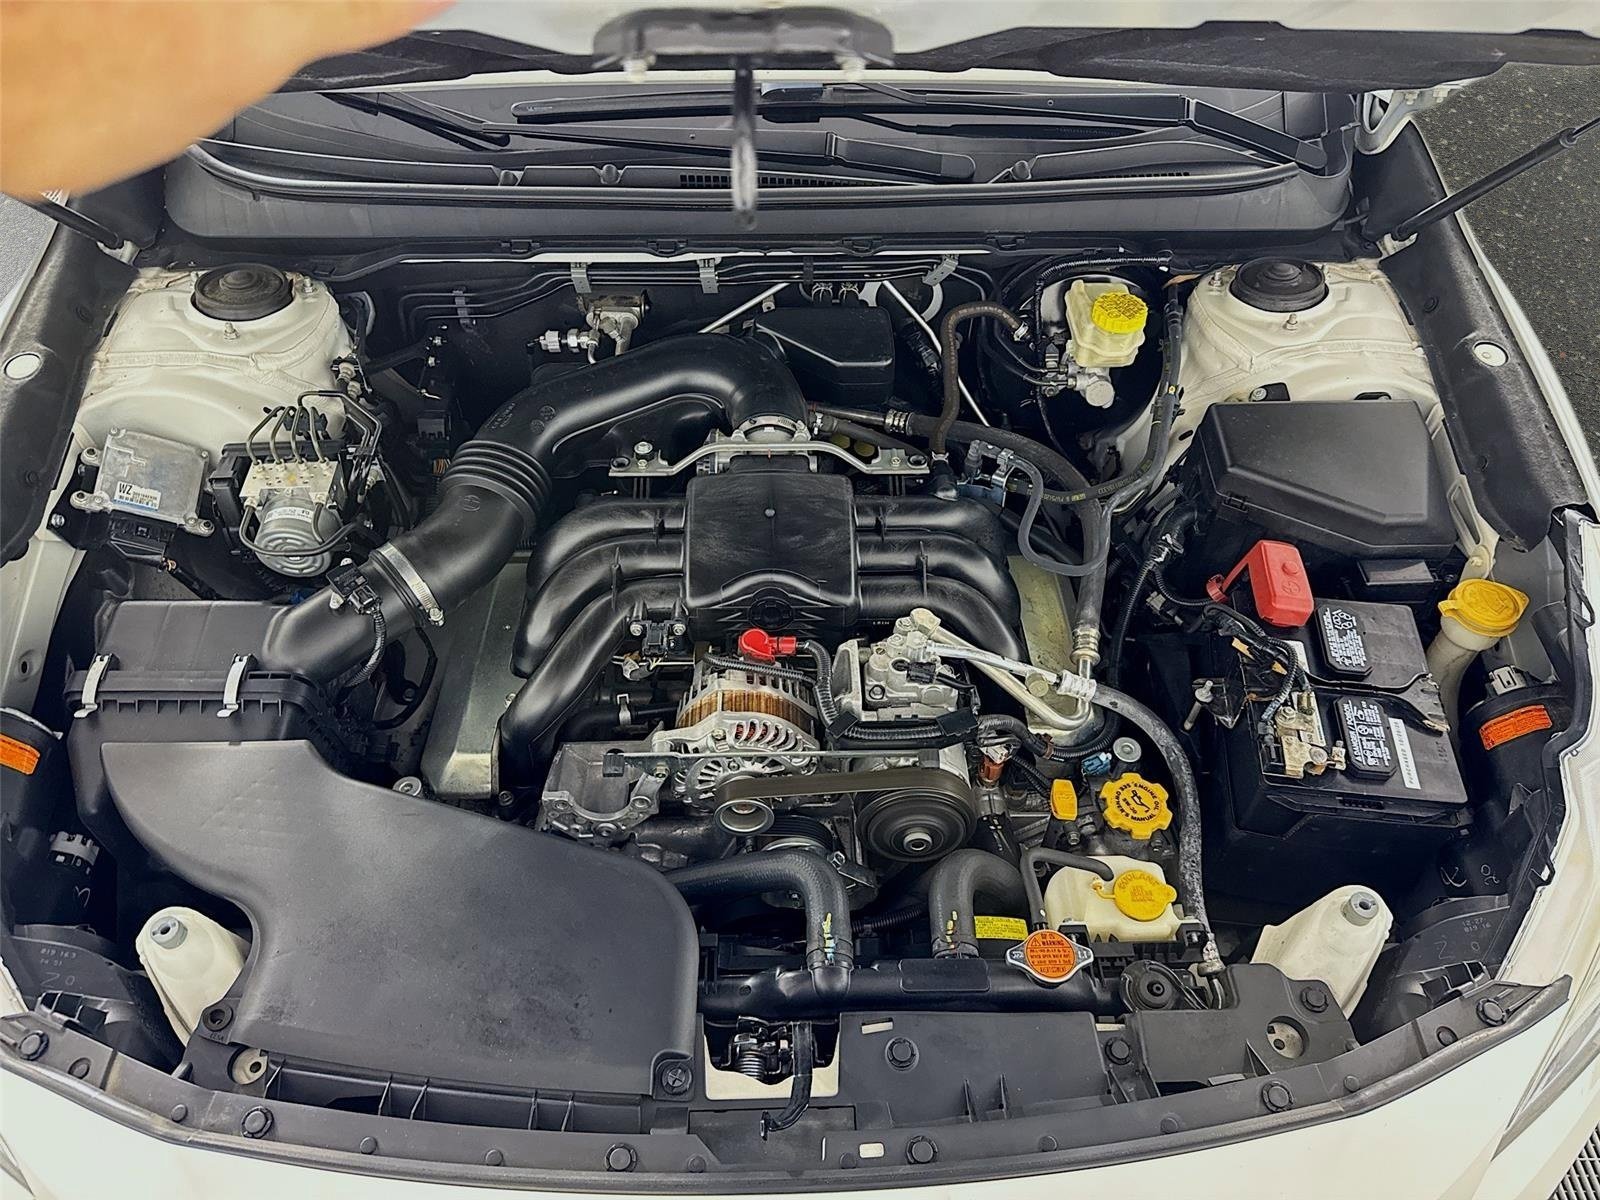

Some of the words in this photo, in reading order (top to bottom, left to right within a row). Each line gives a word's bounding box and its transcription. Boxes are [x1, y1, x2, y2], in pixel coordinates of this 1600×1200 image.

[119, 482, 133, 496] WZ
[1134, 783, 1158, 799] ENGINE
[1131, 813, 1157, 822] MANUAL
